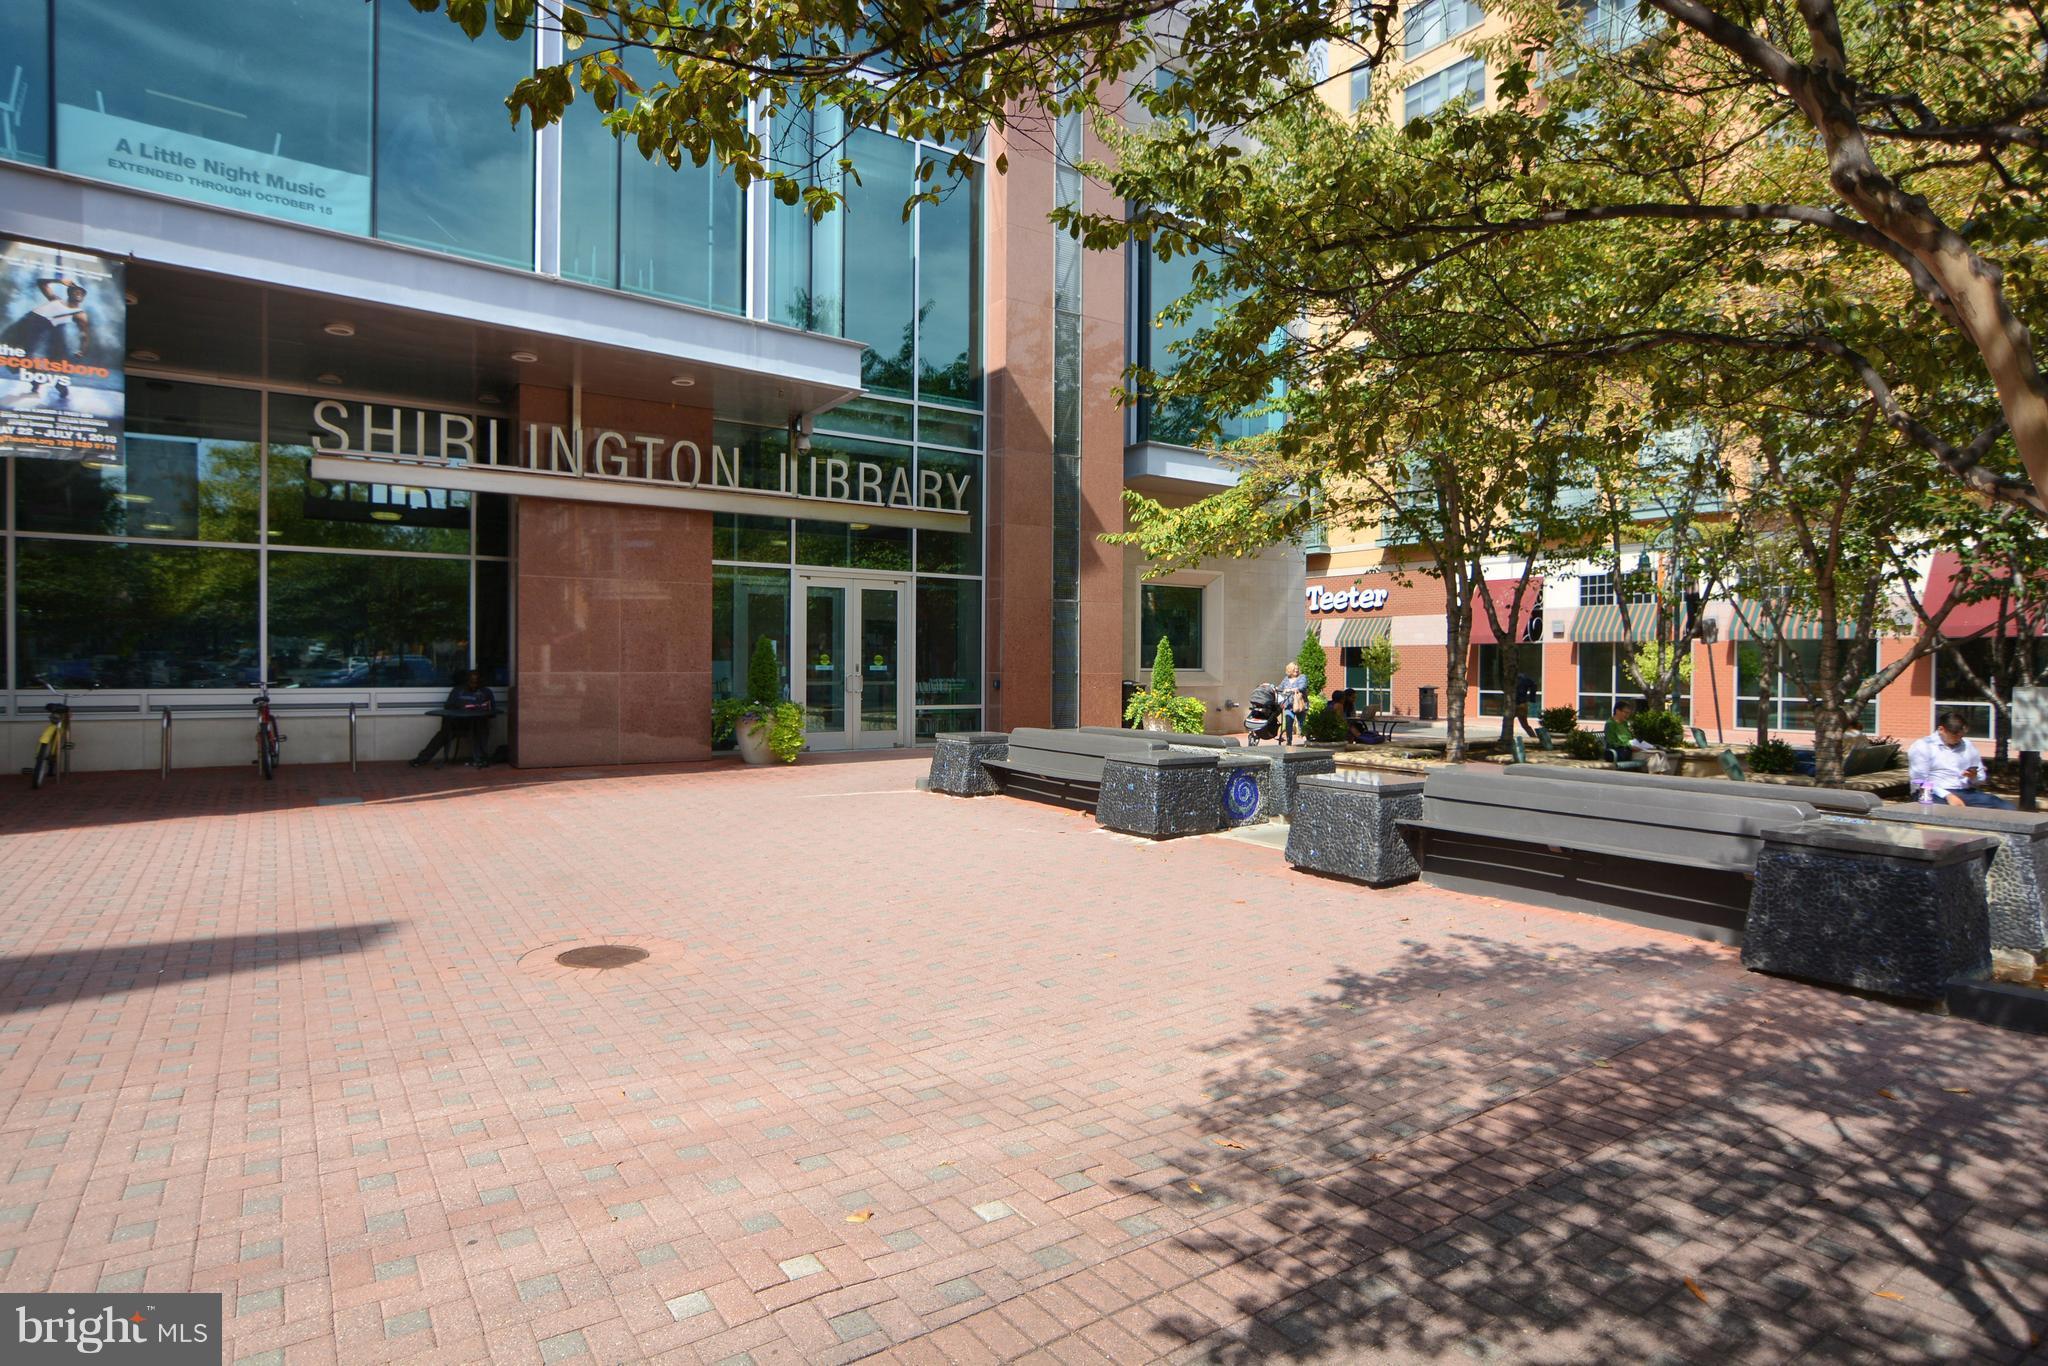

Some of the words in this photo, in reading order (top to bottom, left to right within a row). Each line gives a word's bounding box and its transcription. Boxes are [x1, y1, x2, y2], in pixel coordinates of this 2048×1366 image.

[107, 158, 184, 183] EXTENDED
[187, 176, 252, 199] THROUGH
[254, 191, 316, 212] OCTOBER
[319, 206, 333, 216] 15
[115, 138, 132, 155] A
[140, 142, 197, 169] Little
[203, 157, 260, 184] Night
[265, 173, 327, 199] Music
[19, 367, 71, 387] boys
[16, 426, 34, 436] 22
[43, 428, 74, 439] JULY
[75, 431, 88, 441] 1,
[88, 433, 117, 444] 2018
[312, 400, 740, 489] SHIRLINGTON
[780, 452, 972, 511] LIBRARY
[1306, 585, 1388, 612] Teeter
